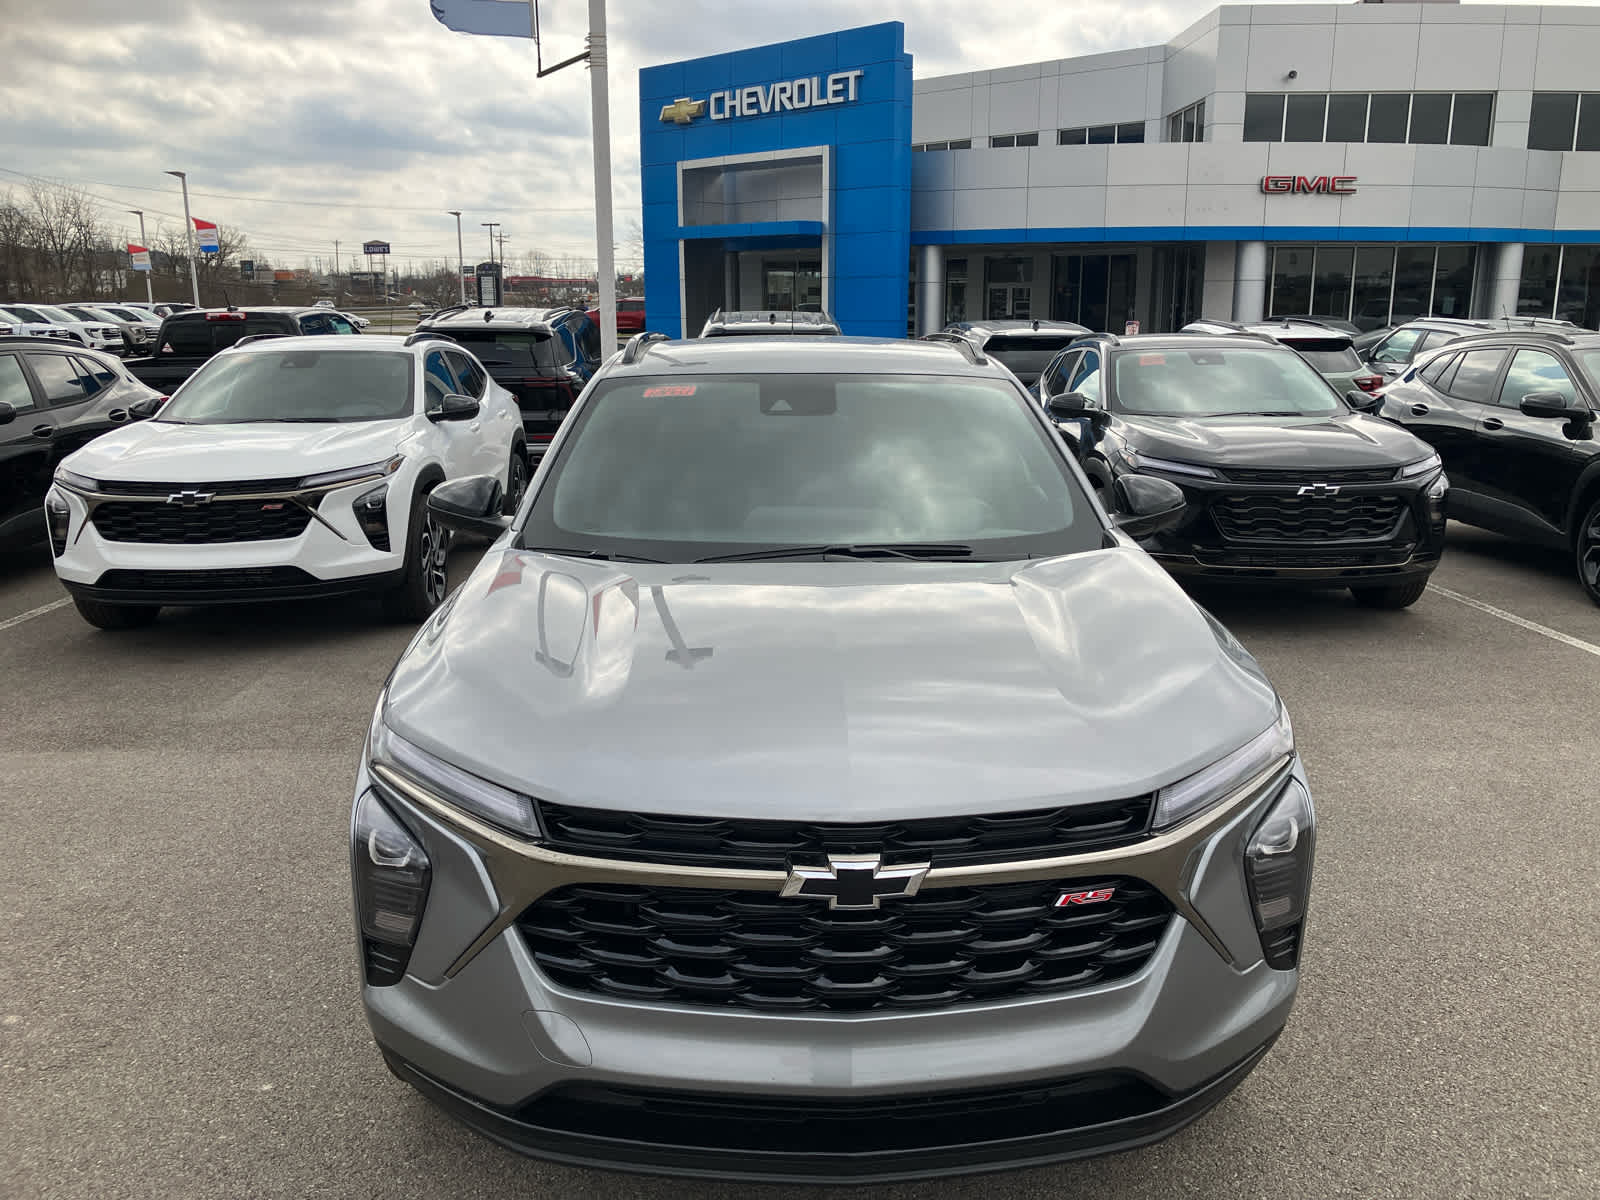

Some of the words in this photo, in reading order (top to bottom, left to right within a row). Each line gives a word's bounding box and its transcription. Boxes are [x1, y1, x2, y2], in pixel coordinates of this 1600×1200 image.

[710, 70, 864, 120] CHEVROLET
[1262, 175, 1358, 193] GMC
[1054, 888, 1116, 907] RS
